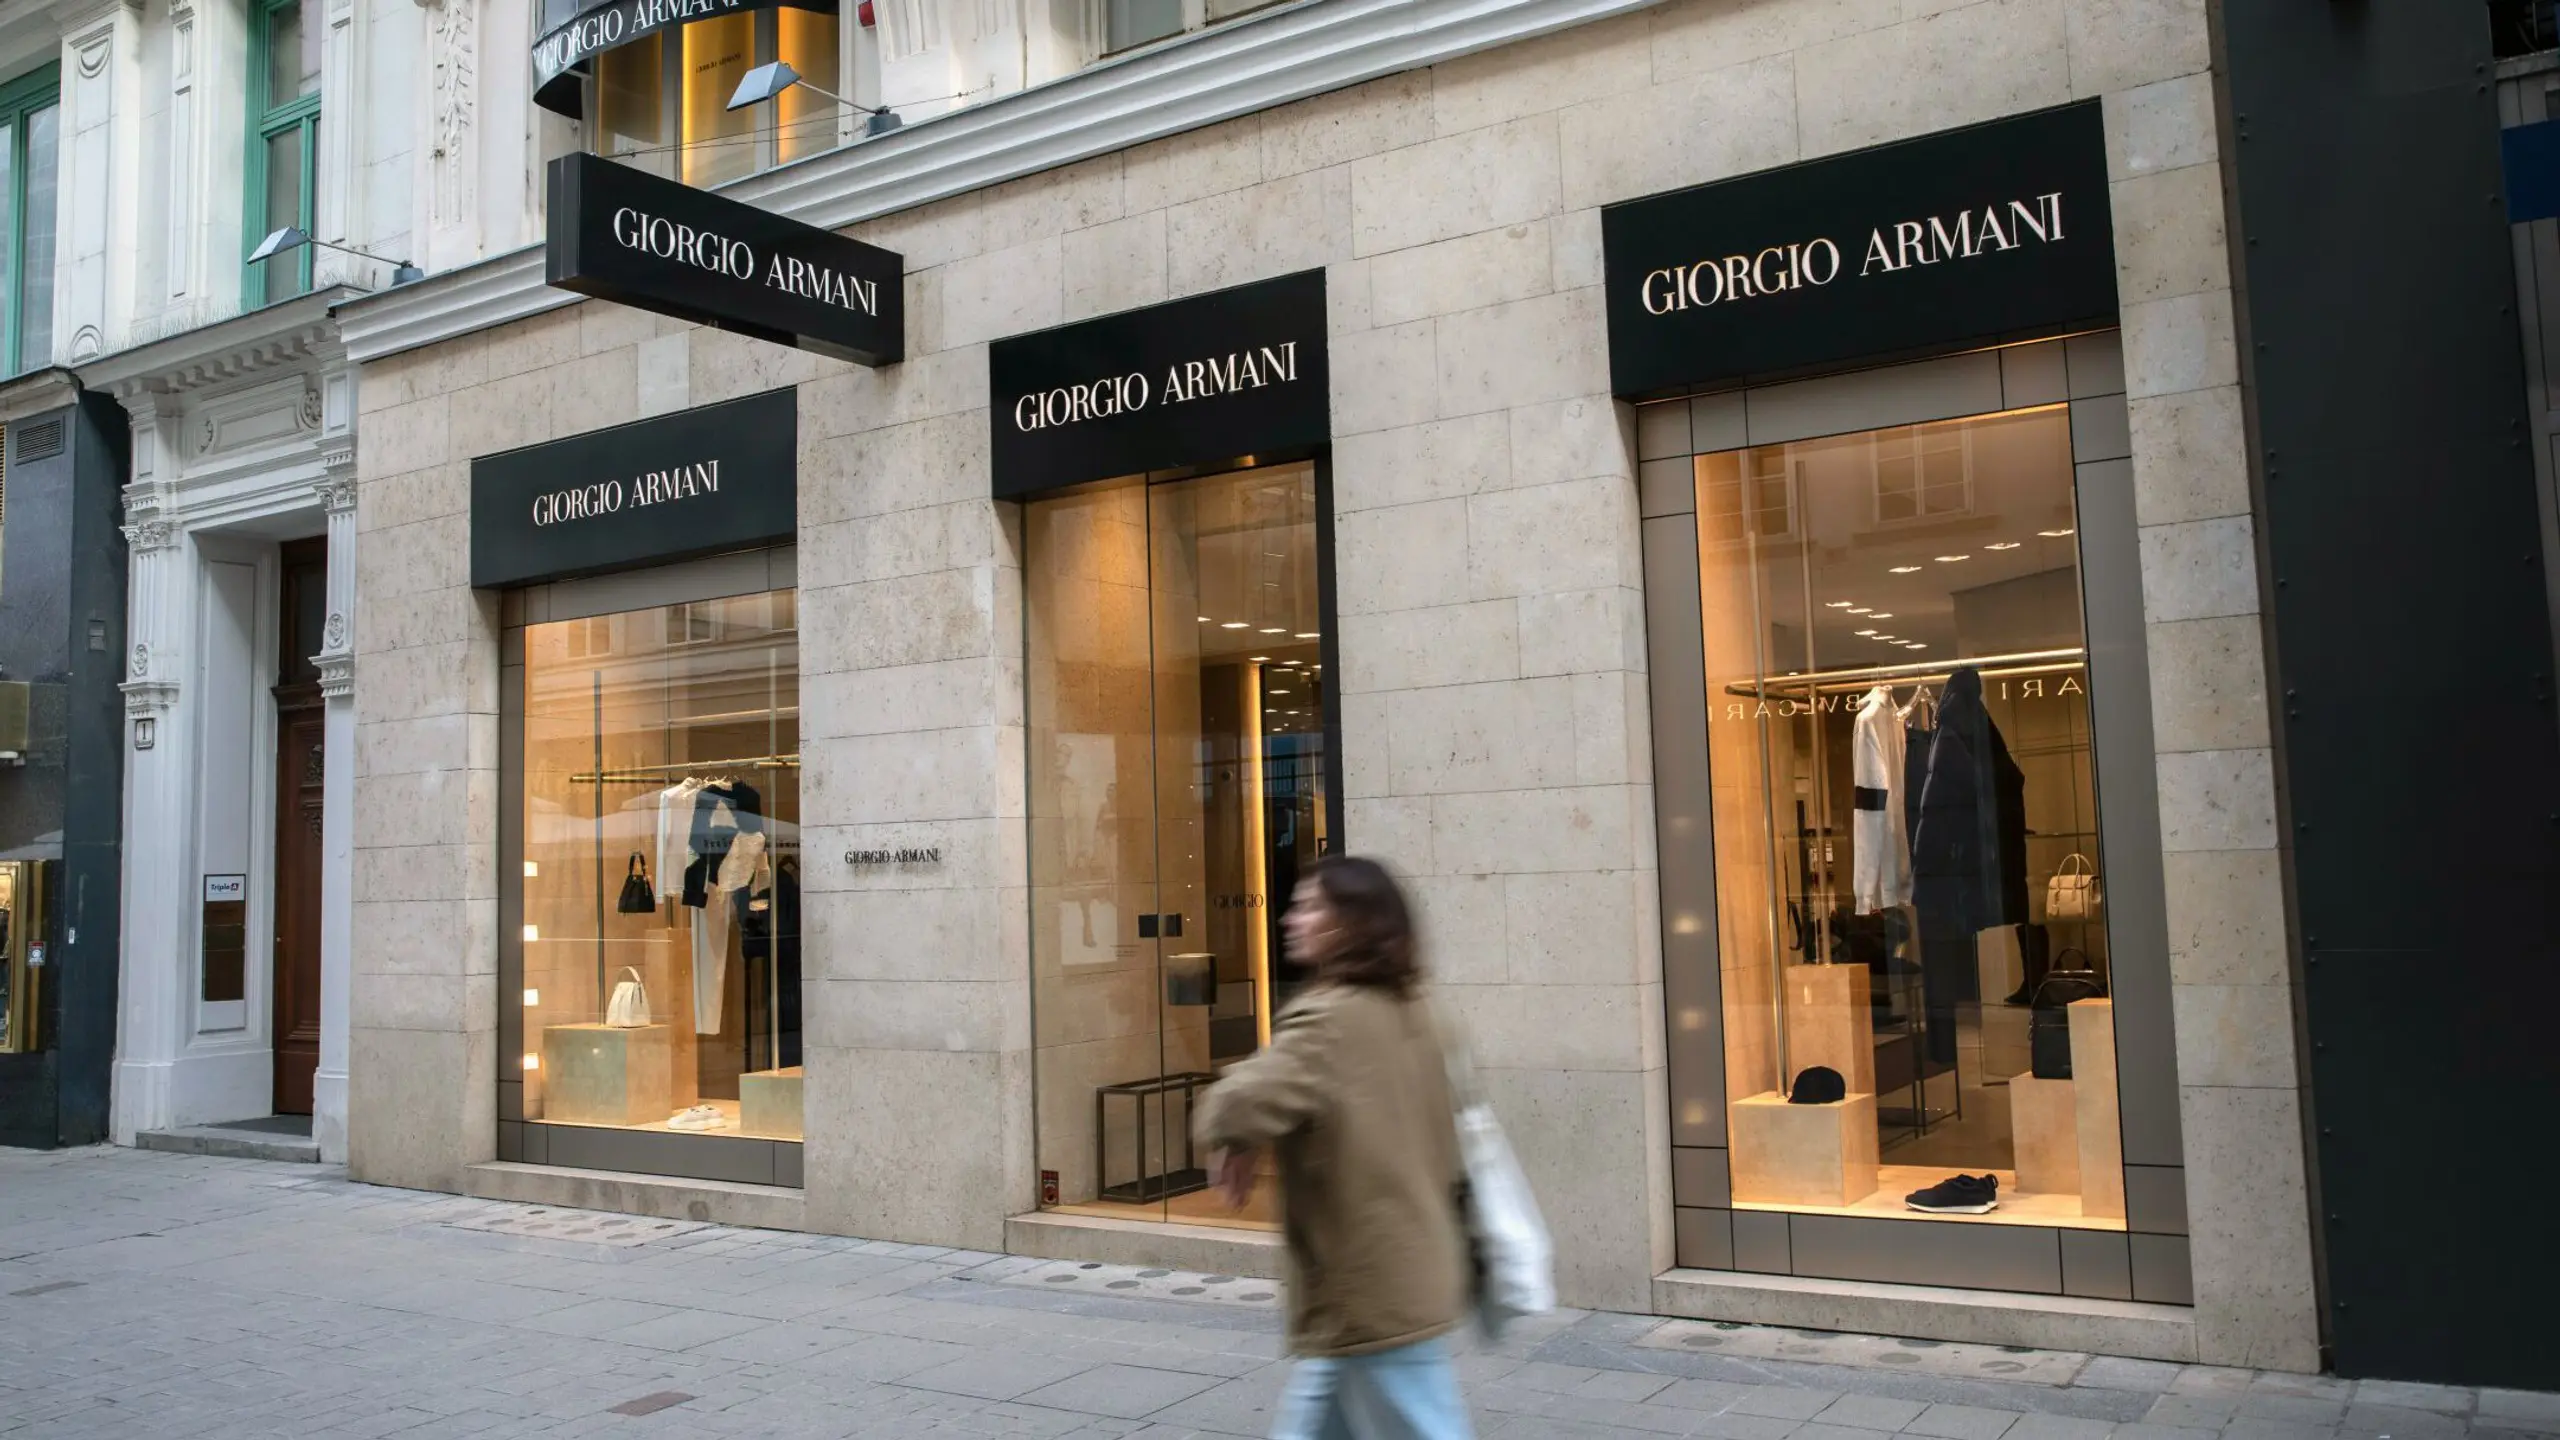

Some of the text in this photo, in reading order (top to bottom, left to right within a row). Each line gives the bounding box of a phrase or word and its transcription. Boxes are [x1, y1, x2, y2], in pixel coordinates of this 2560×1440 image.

[541, 9, 623, 76] GIORGIO
[613, 207, 878, 317] GIORGIO ARMANI
[1641, 192, 2065, 316] GIORGIO ARMANI
[1015, 341, 1298, 432] GIORGIO ARMANI
[533, 459, 719, 526] GIORGIO ARMANI
[844, 847, 939, 865] GIORGIO ARMANI
